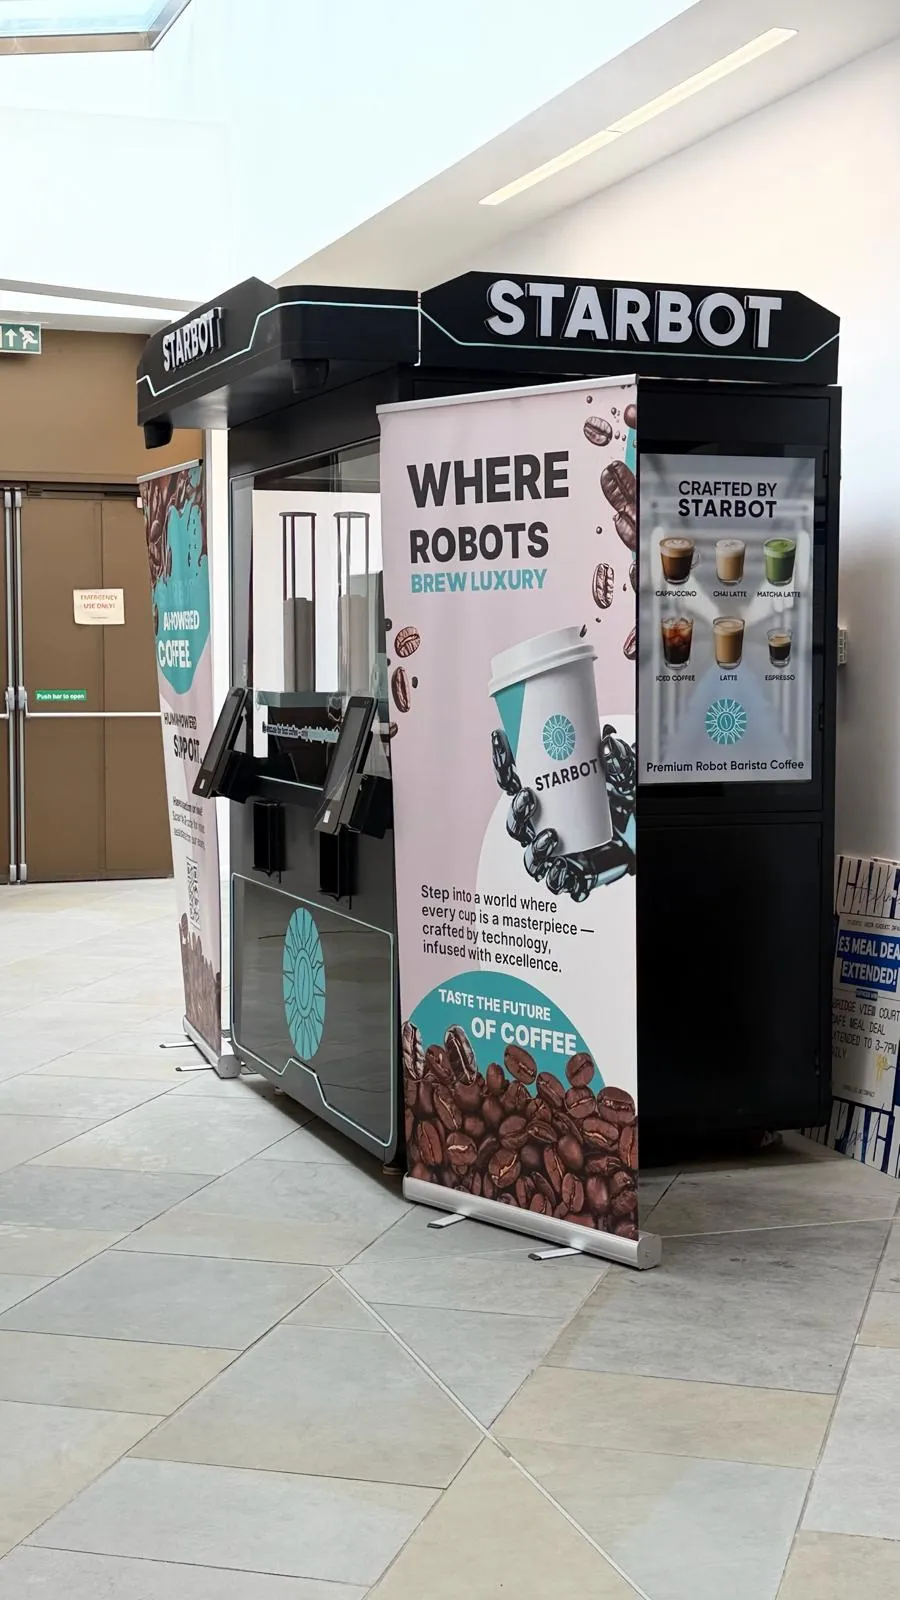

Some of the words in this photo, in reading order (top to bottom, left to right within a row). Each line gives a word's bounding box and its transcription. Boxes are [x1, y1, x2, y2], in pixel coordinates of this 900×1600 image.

[484, 279, 783, 349] STARBOT
[163, 307, 221, 372] STARBOT
[406, 450, 569, 508] WHERE
[678, 480, 752, 497] CRAFTED
[757, 482, 777, 498] BY
[678, 498, 777, 518] STARBOT
[409, 521, 549, 564] ROBOTS
[410, 570, 469, 594] BREW
[471, 568, 548, 592] LUXURY
[655, 590, 697, 598] CAPPUCCINO
[712, 590, 728, 598] CHAI
[729, 590, 747, 598] LATTE
[655, 674, 671, 682] ICED
[671, 674, 696, 682] COFFEE
[719, 674, 738, 682] LATTE
[764, 674, 796, 682] ESPRESSO
[535, 758, 599, 792] STARBOT
[646, 762, 693, 774] Premium
[695, 761, 728, 773] Robot
[730, 760, 767, 772] Barista
[769, 759, 805, 771] Coffee
[421, 884, 449, 903] Step
[453, 886, 472, 903] into
[474, 892, 481, 904] a
[483, 893, 517, 908] world
[520, 896, 557, 913] where
[421, 905, 456, 922] every
[458, 910, 477, 924] cup
[479, 909, 489, 924] is
[492, 914, 499, 926] a
[502, 914, 578, 936] masterpiece
[422, 923, 464, 939] crafted
[466, 925, 479, 944] by
[482, 929, 552, 955] technology,
[838, 935, 850, 953] £3
[851, 937, 878, 957] MEAL
[423, 940, 466, 958] infused
[467, 946, 492, 963] with
[494, 952, 562, 974] excellence.
[841, 960, 898, 986] EXTENDED!
[438, 989, 474, 1008] TASTE
[475, 994, 501, 1013] THE
[502, 1000, 551, 1022] FUTURE
[859, 1004, 876, 1017] VIEW
[879, 1007, 900, 1022] COURT
[471, 1016, 497, 1040] OF
[500, 1022, 577, 1056] COFFEE
[850, 1018, 865, 1032] MEAL
[869, 1021, 886, 1036] DEAL
[864, 1036, 872, 1049] TO
[875, 1039, 897, 1055] 3-7PM
